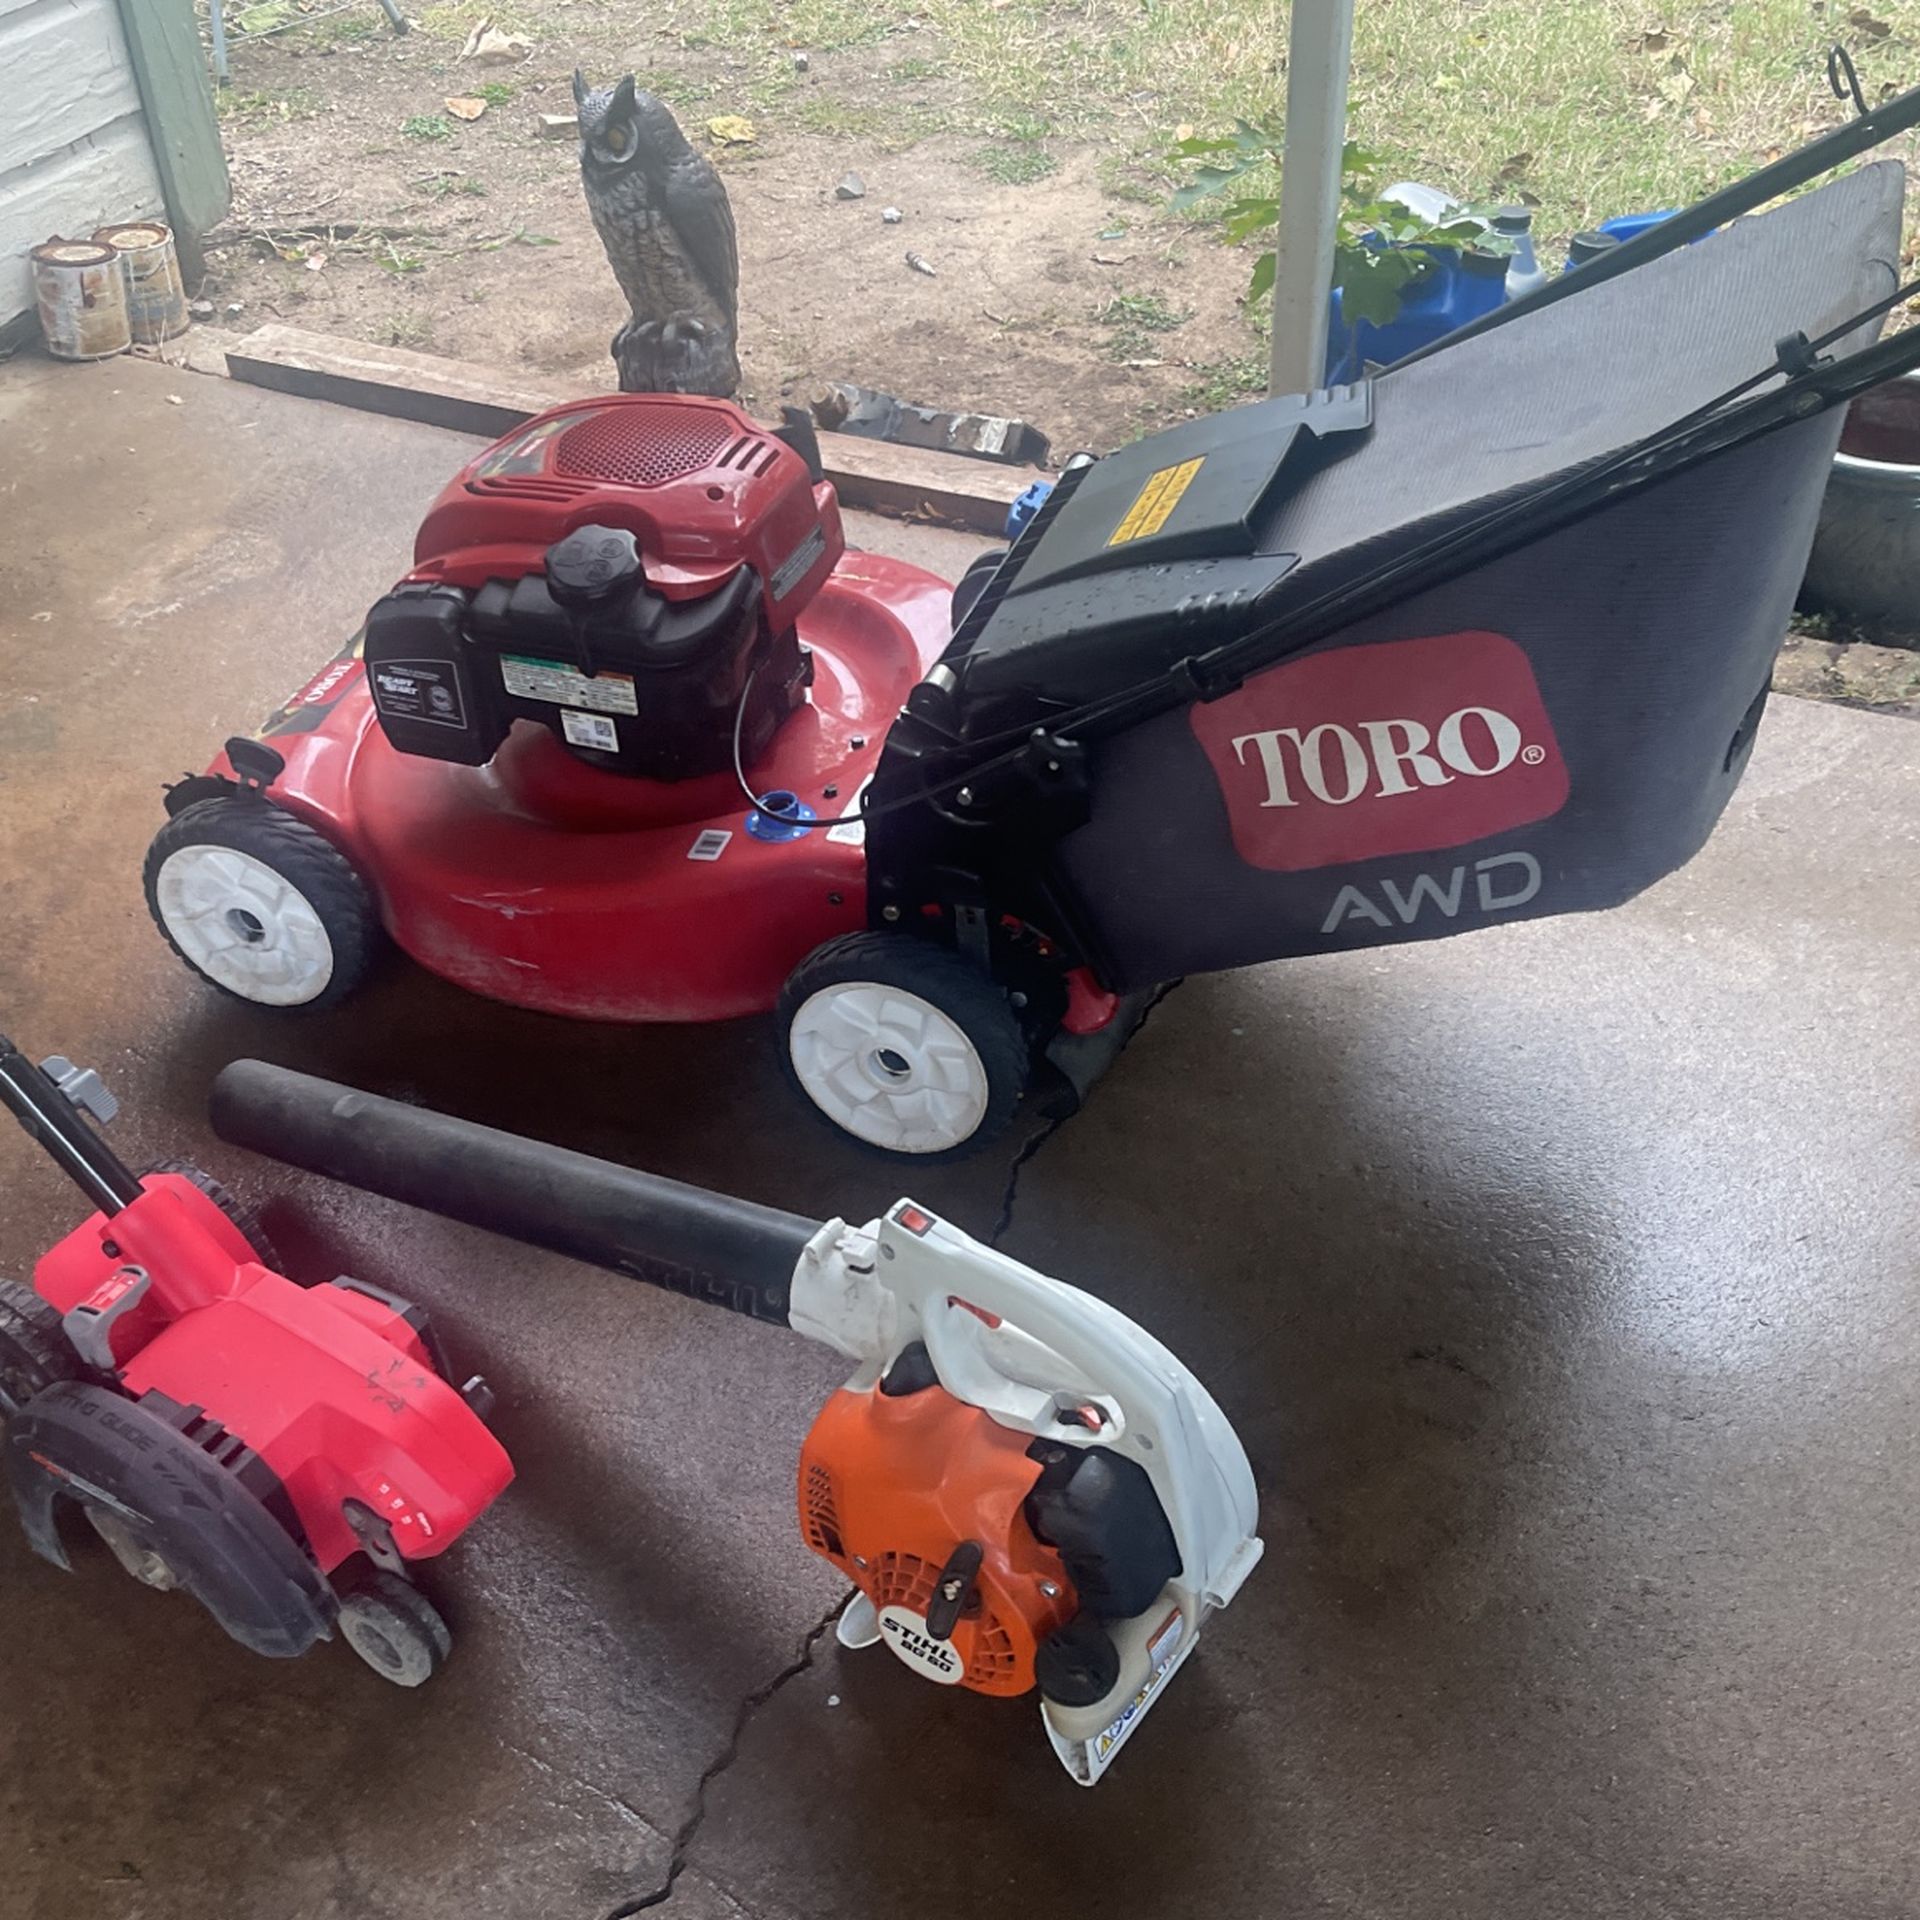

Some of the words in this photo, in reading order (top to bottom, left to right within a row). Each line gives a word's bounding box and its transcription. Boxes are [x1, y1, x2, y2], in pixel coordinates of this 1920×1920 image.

[1232, 706, 1522, 808] TORO
[1320, 851, 1542, 934] AWD
[882, 1616, 955, 1666] STIHL
